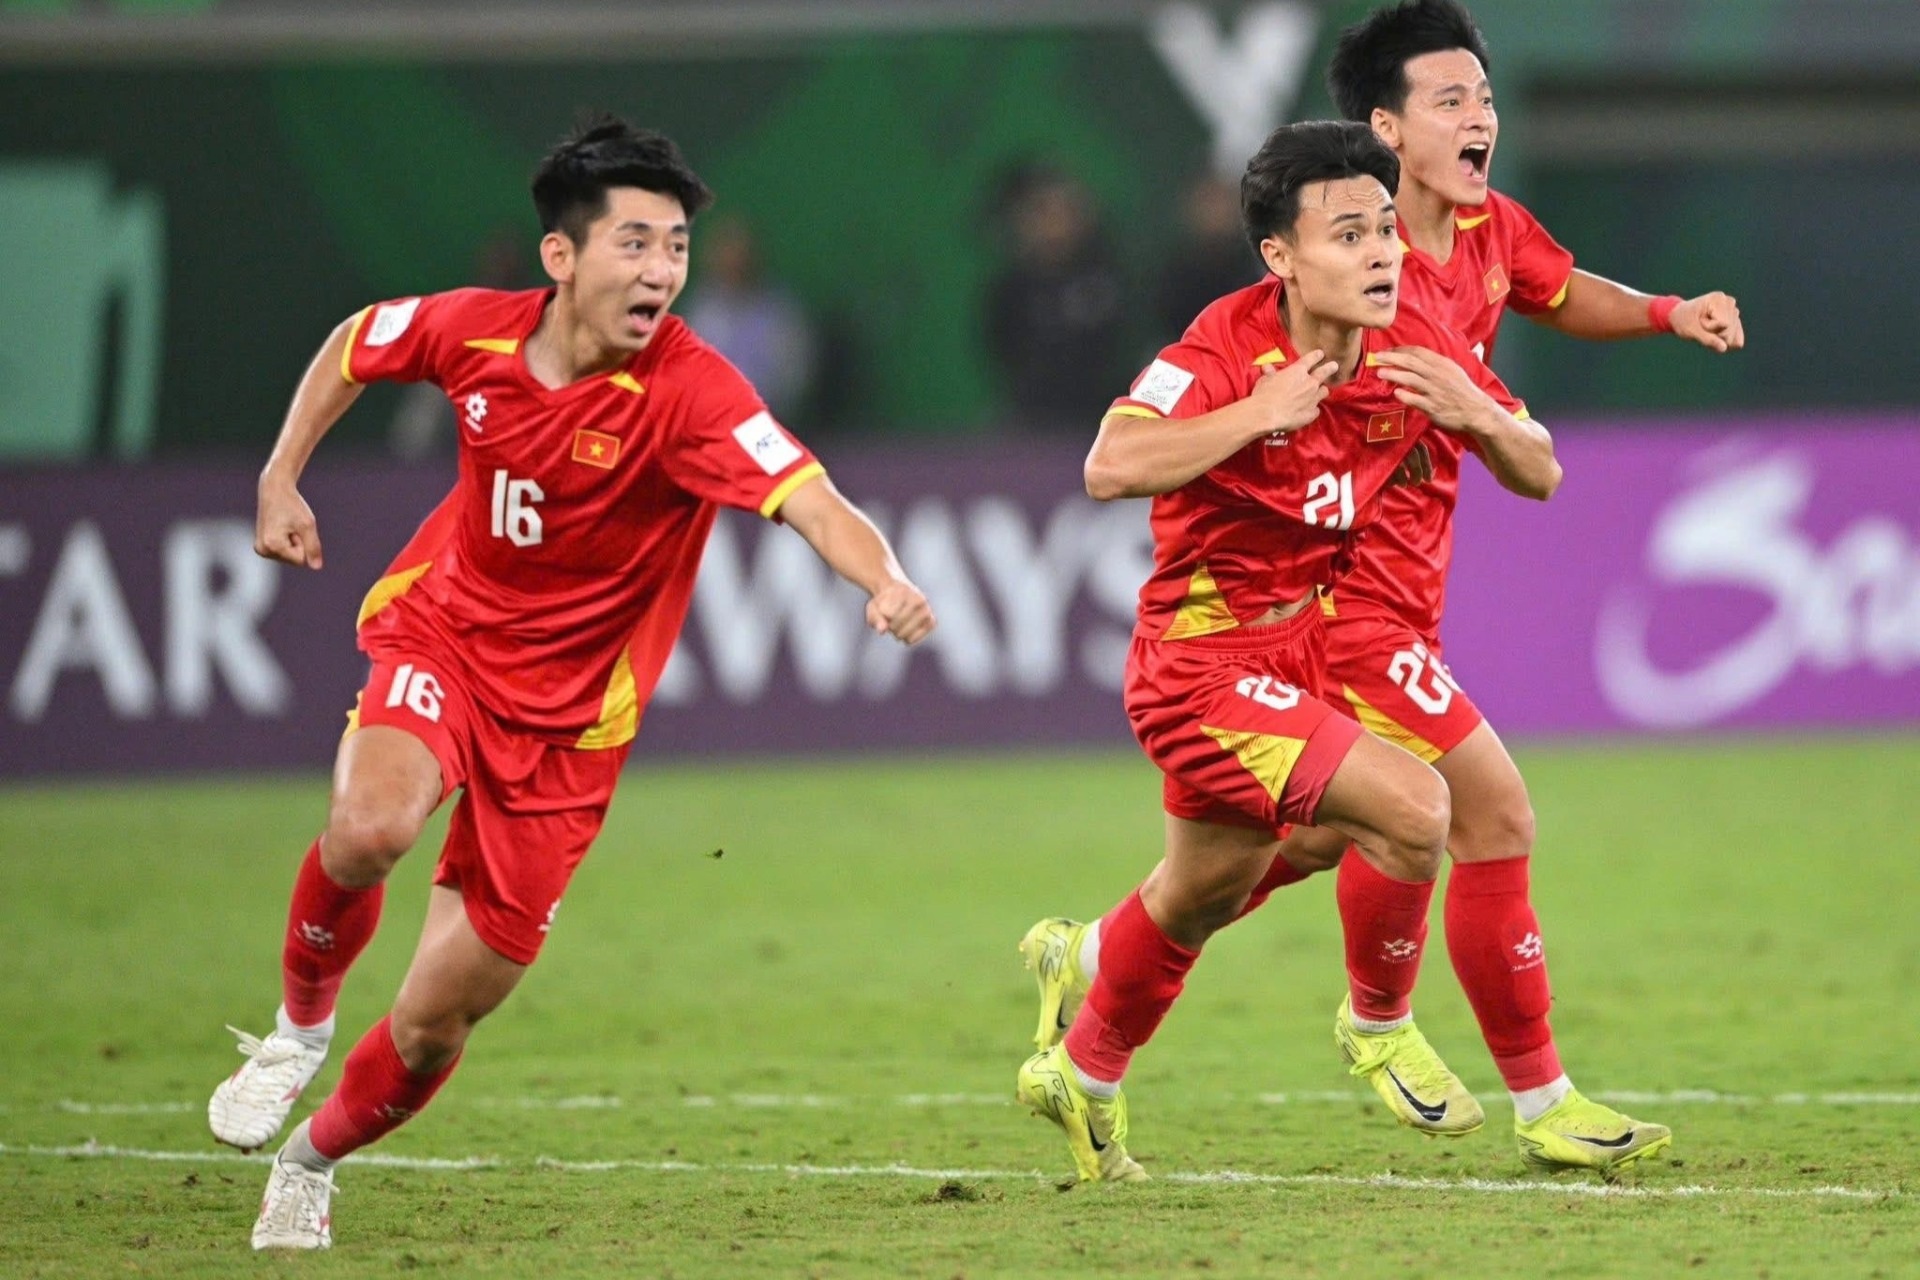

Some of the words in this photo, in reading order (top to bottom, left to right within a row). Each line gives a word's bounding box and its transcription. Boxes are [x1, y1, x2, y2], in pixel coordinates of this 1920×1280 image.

[491, 469, 545, 547] 16
[1303, 470, 1355, 531] 21
[0, 517, 297, 724] AR
[385, 663, 445, 723] 16
